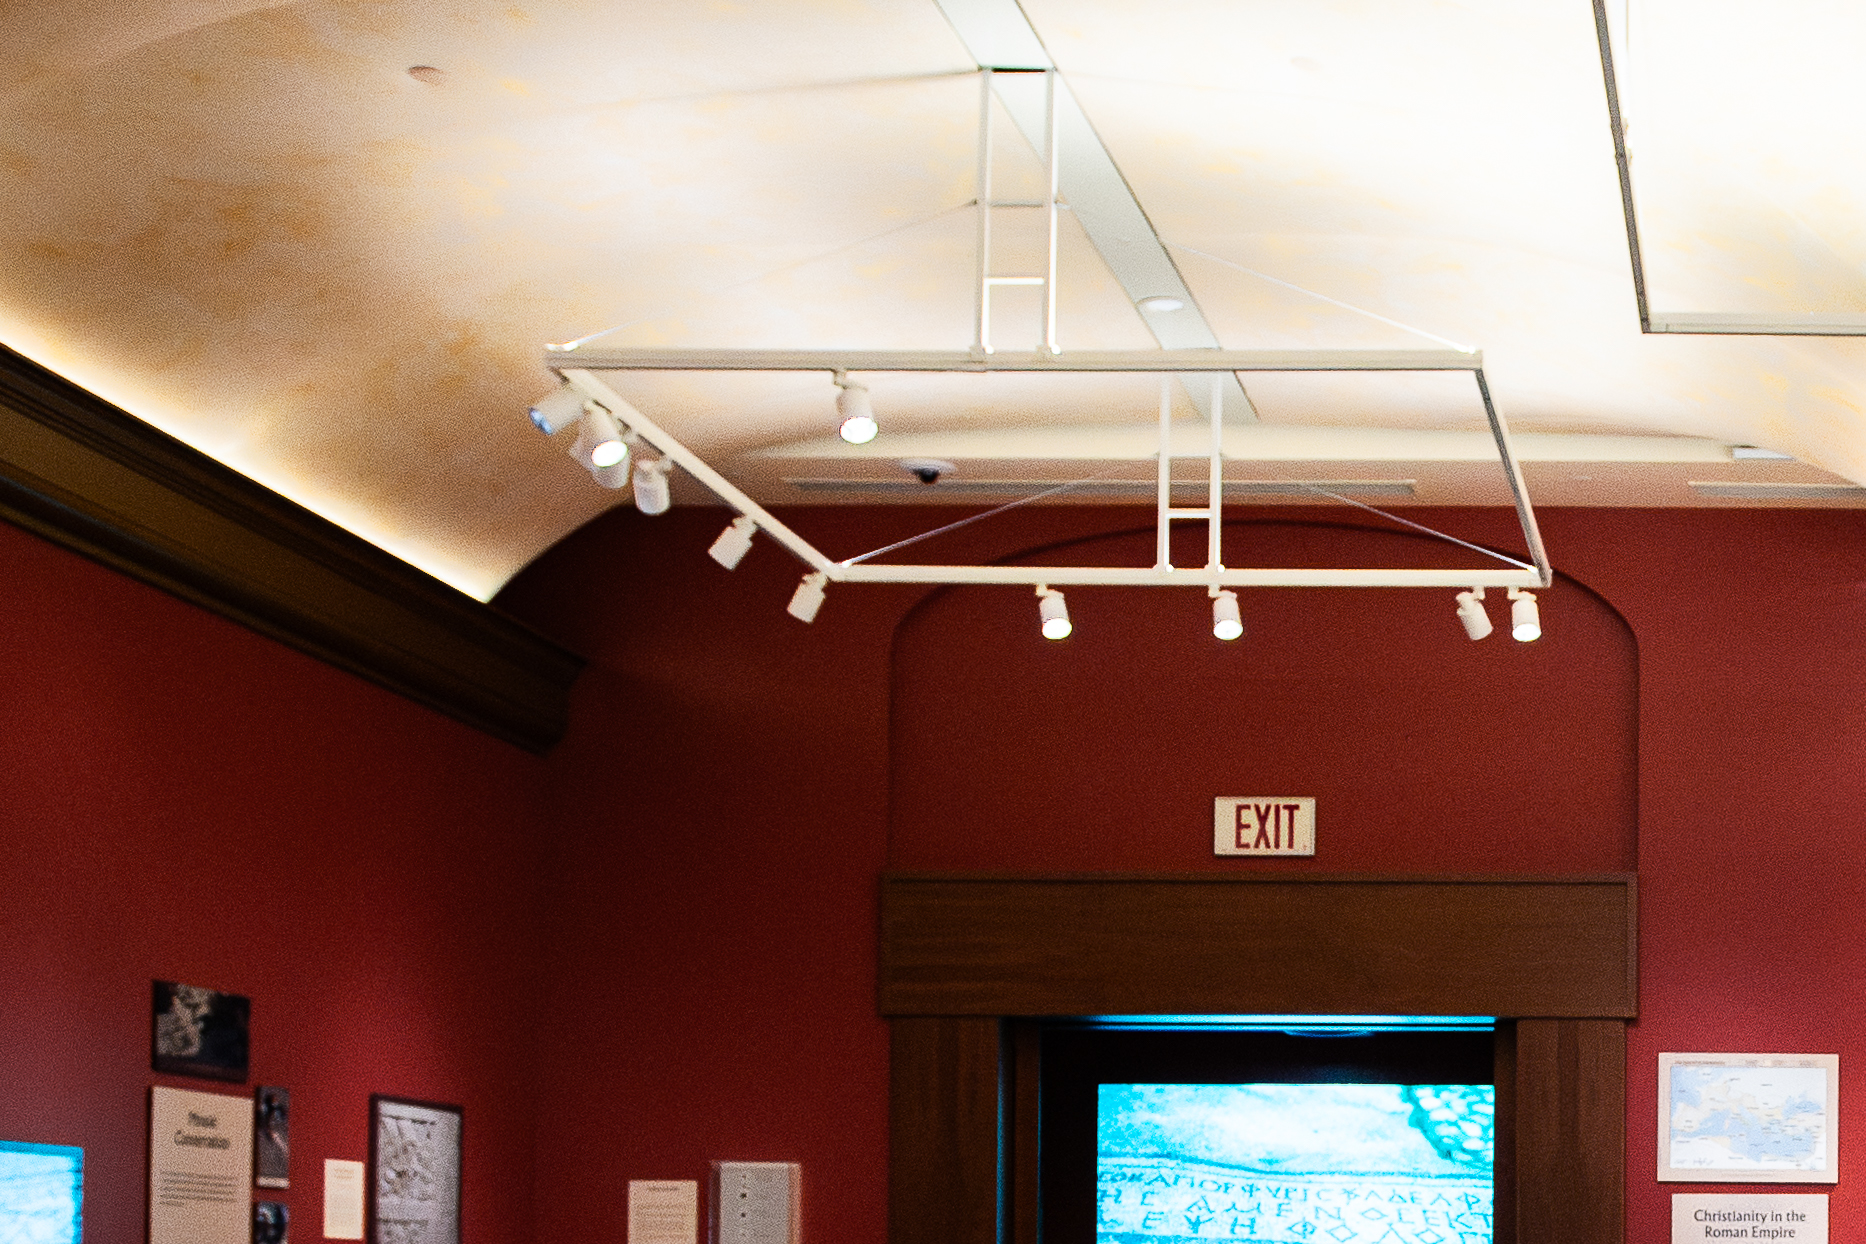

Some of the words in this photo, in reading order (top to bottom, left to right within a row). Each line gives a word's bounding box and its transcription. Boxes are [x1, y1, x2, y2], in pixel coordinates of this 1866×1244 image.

[1235, 803, 1300, 849] EXIT
[1693, 1209, 1767, 1223] Christianity
[1771, 1209, 1782, 1221] in
[1786, 1209, 1806, 1222] the
[1705, 1225, 1748, 1238] Roman
[1752, 1225, 1796, 1240] Empire
